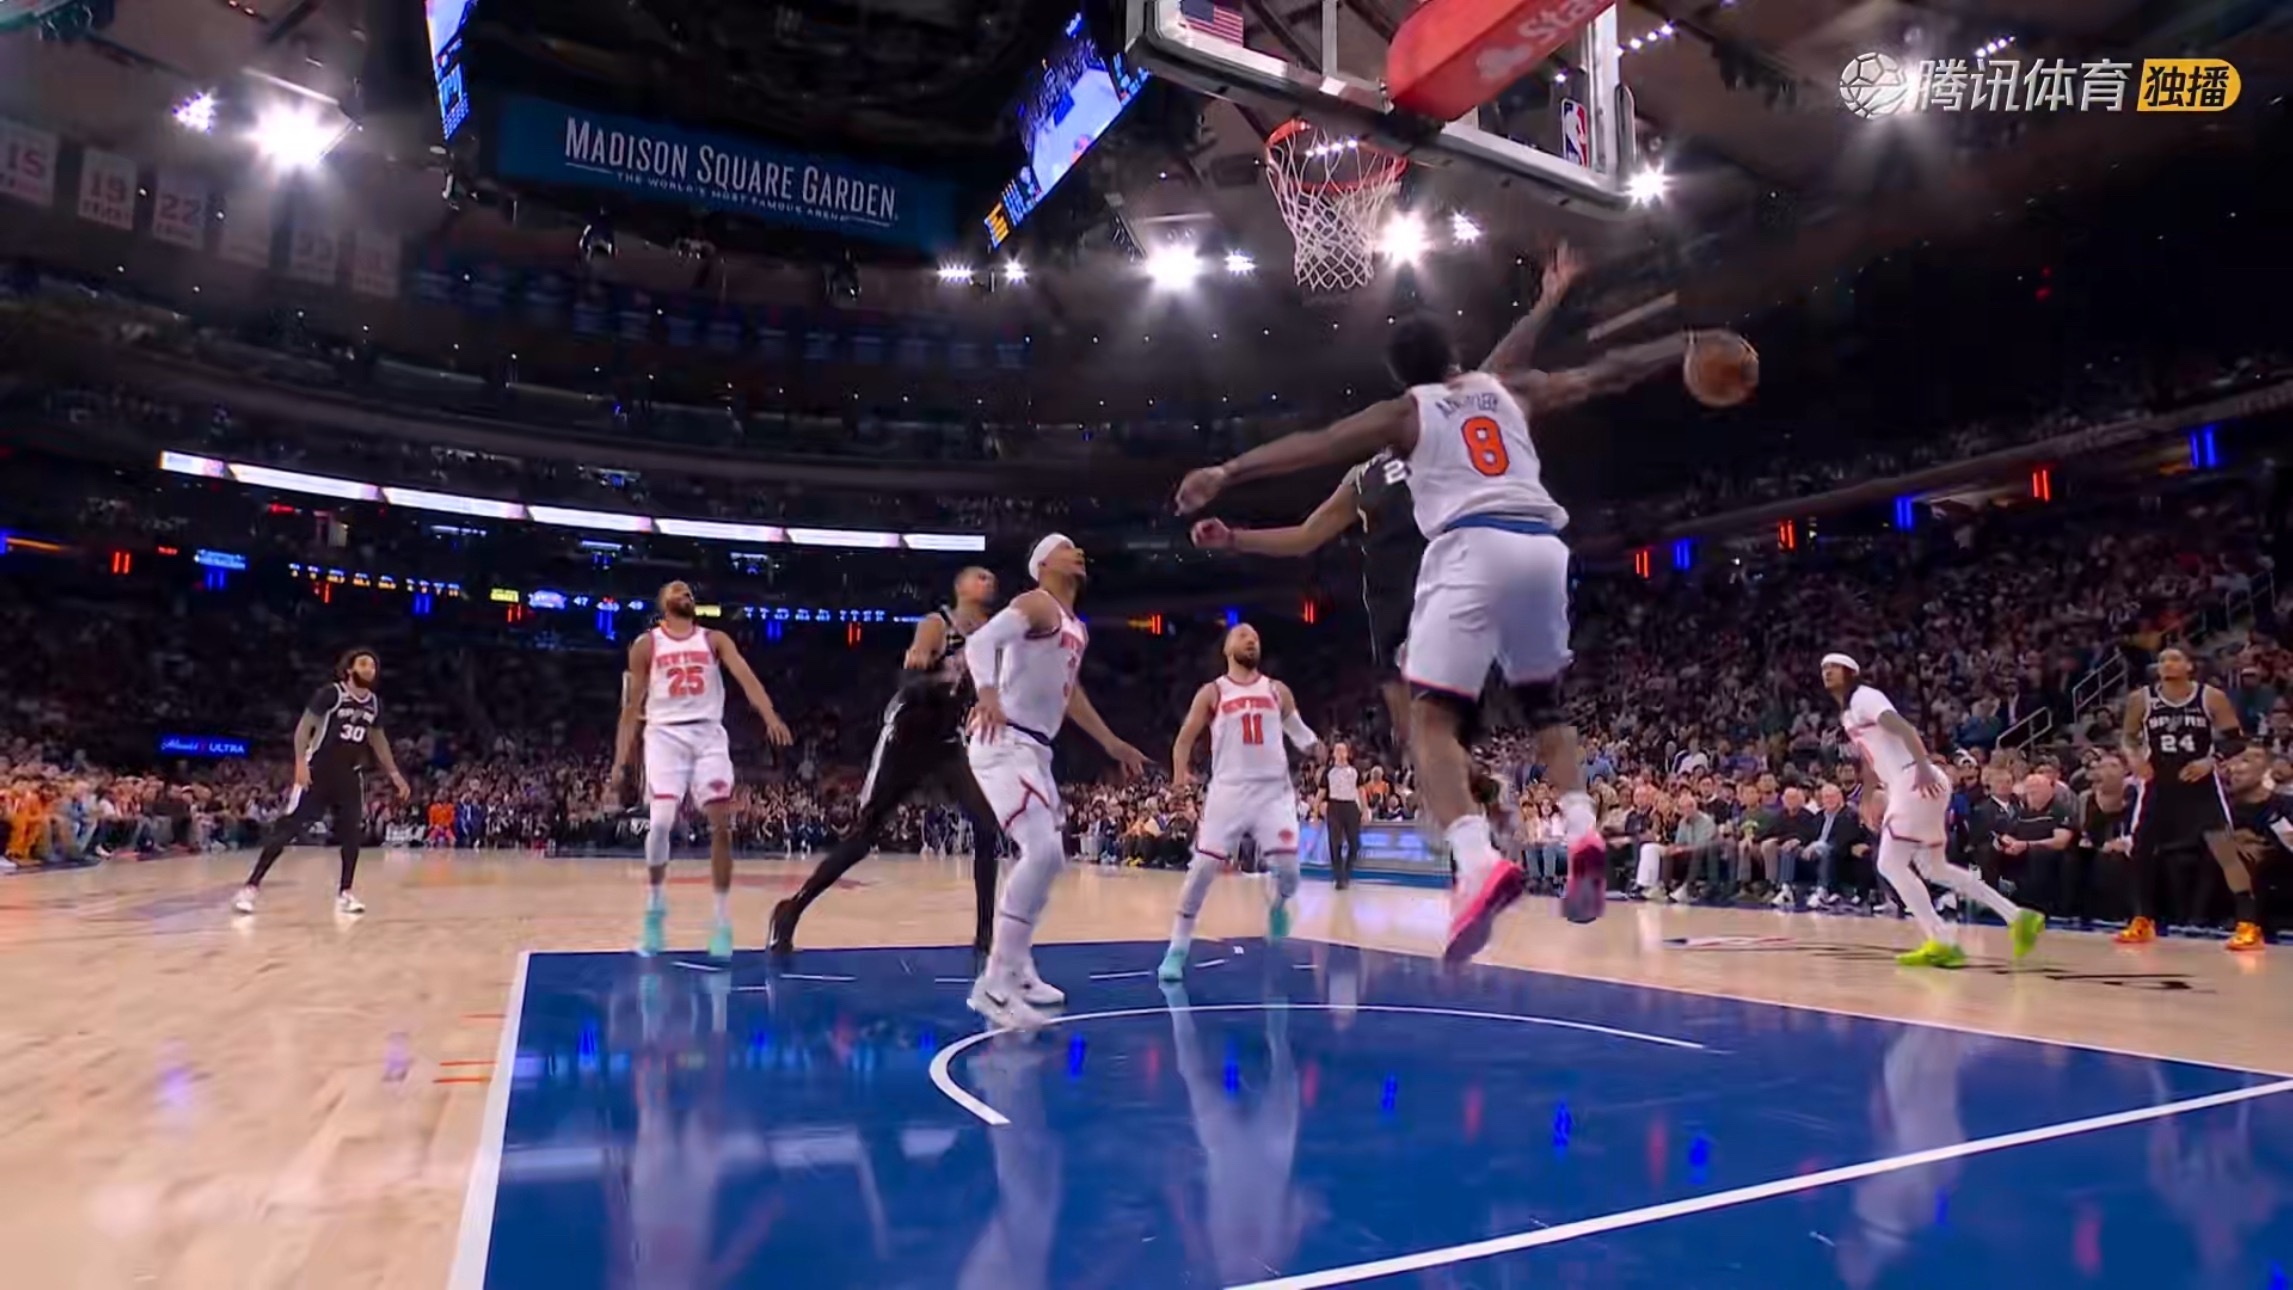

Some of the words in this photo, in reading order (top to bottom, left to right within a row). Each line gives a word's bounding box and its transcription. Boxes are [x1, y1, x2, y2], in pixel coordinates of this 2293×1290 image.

[1517, 0, 1604, 44] Sta
[565, 116, 688, 180] MADISON
[697, 145, 795, 200] SQUARE
[803, 166, 896, 221] GARDEN
[617, 172, 642, 185] THE
[711, 189, 747, 203] MOST
[1461, 416, 1510, 477] 8
[667, 665, 705, 698] 25
[340, 723, 366, 743] 30
[1241, 713, 1264, 745] 11
[2160, 734, 2196, 753] 24
